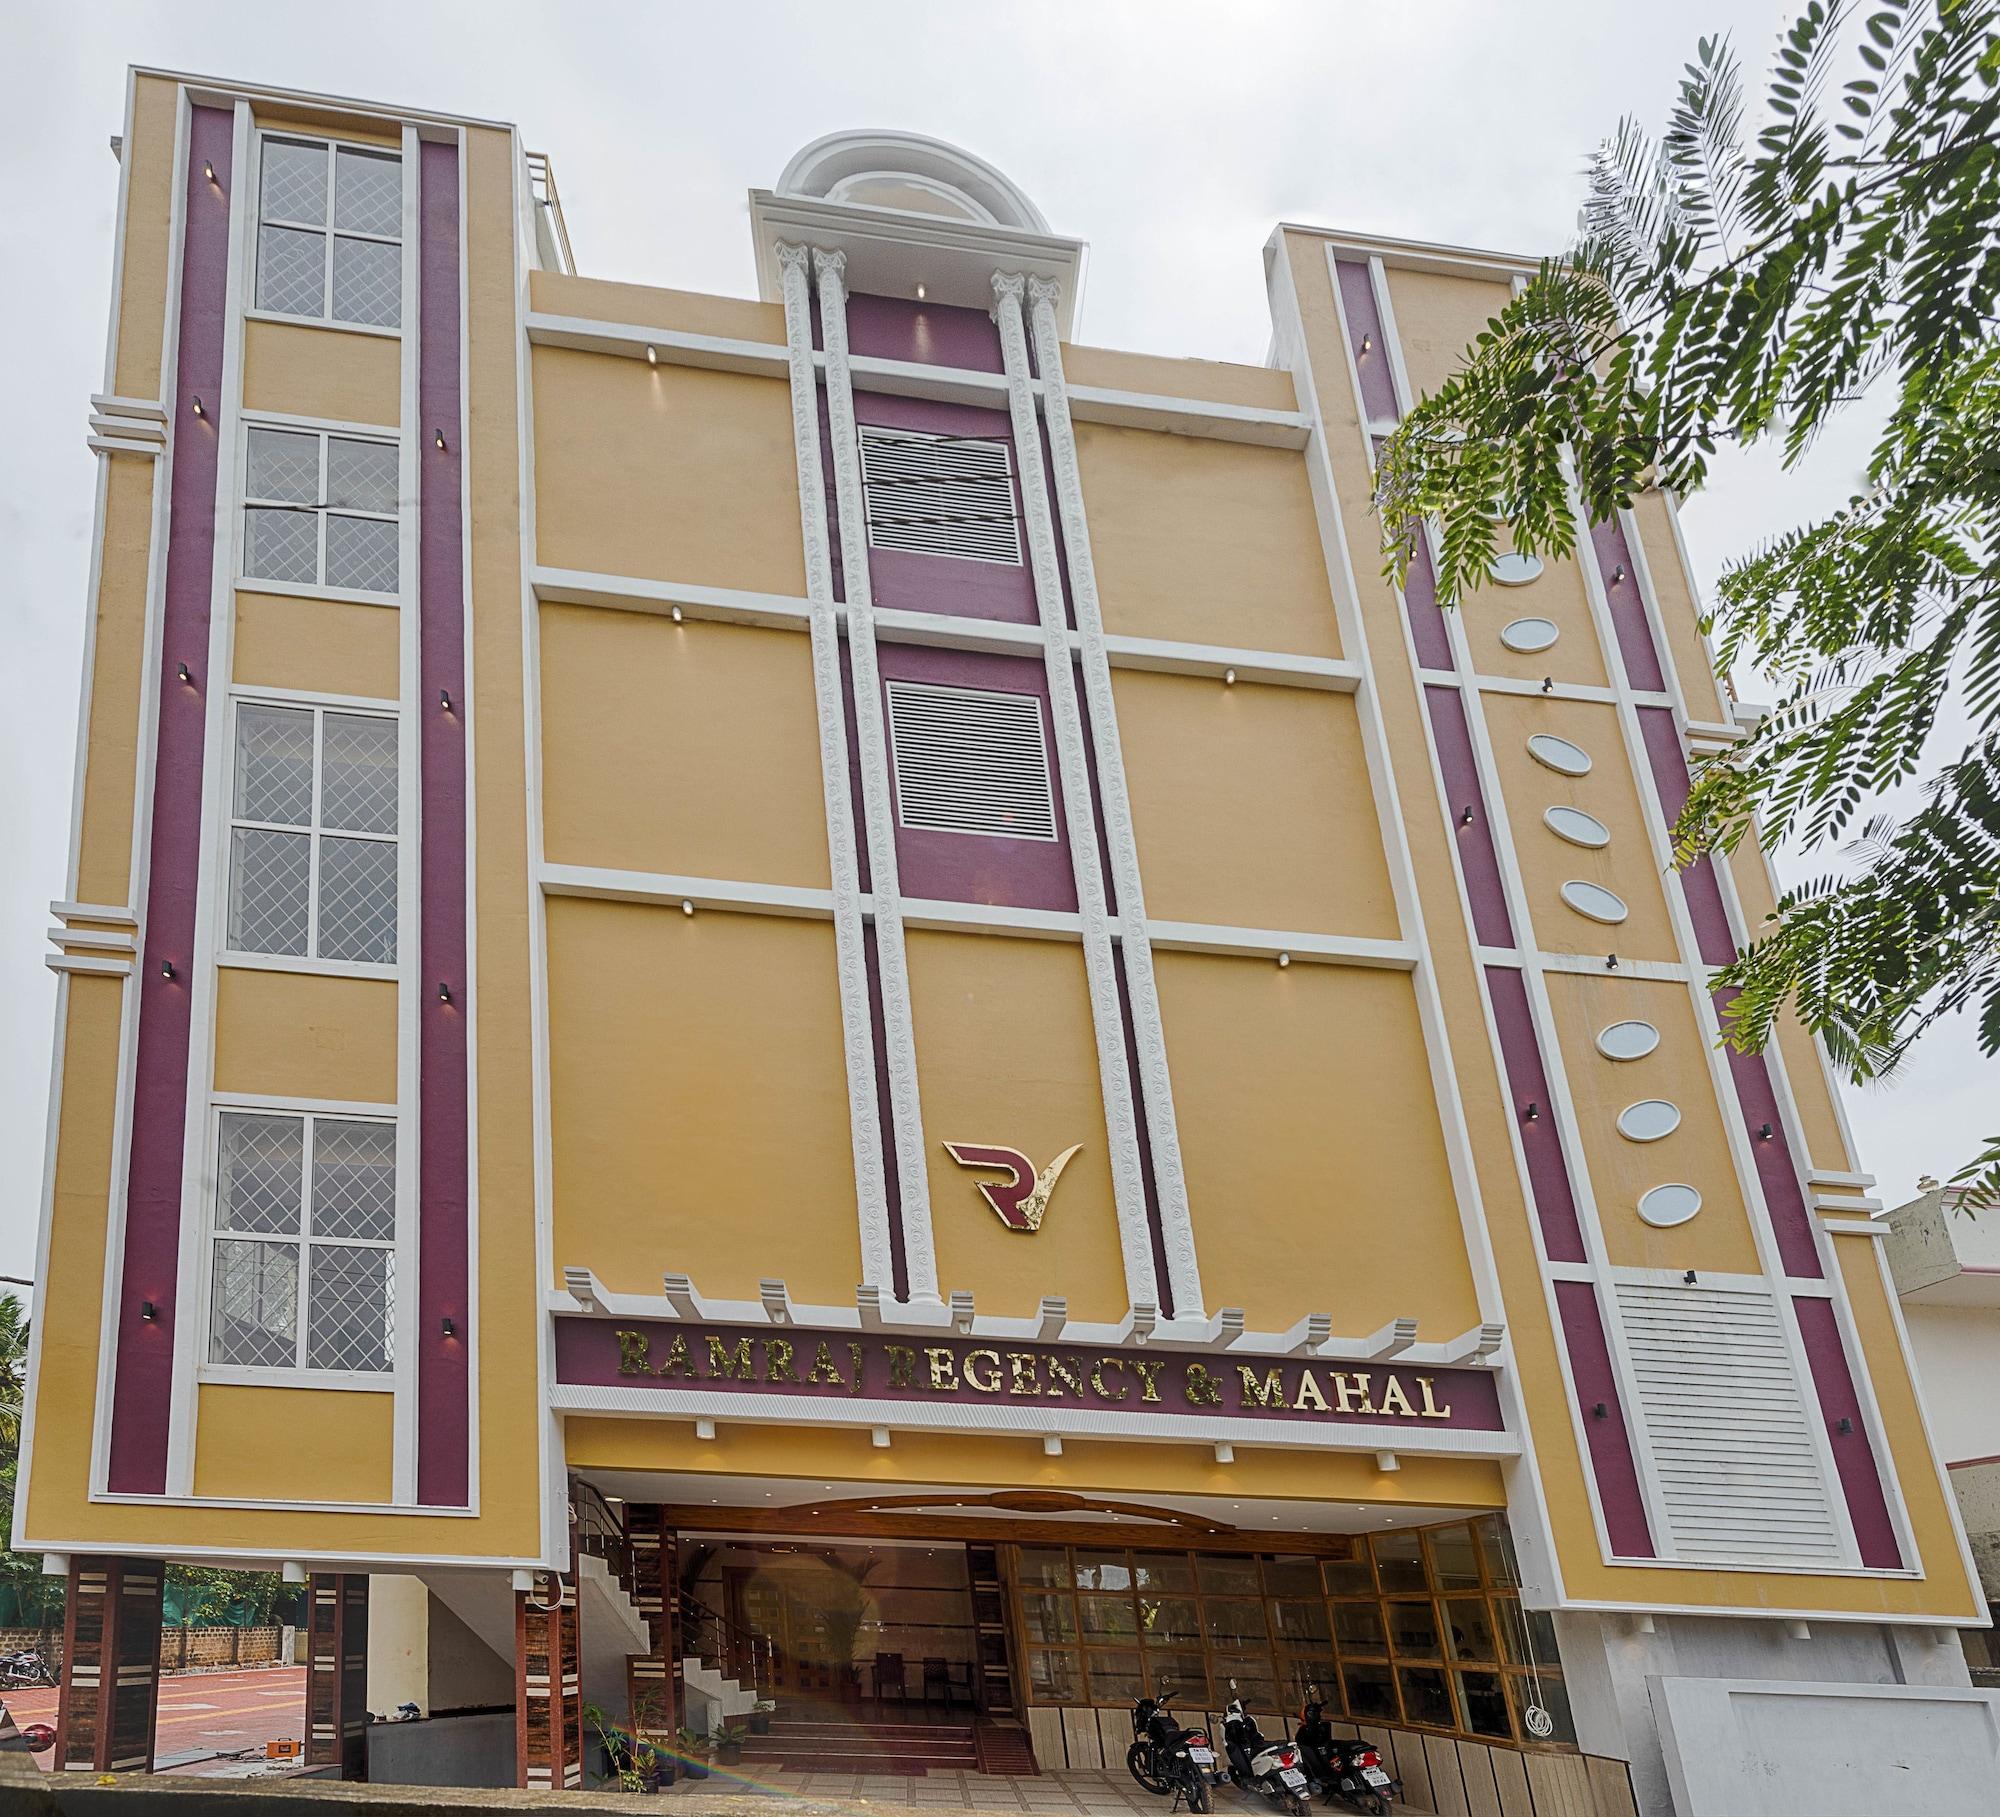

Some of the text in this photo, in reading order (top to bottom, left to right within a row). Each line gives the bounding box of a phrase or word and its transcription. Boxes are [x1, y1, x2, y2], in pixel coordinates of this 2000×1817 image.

[615, 1330, 1451, 1419] RAMRAJ REGENCY & MAHAL
